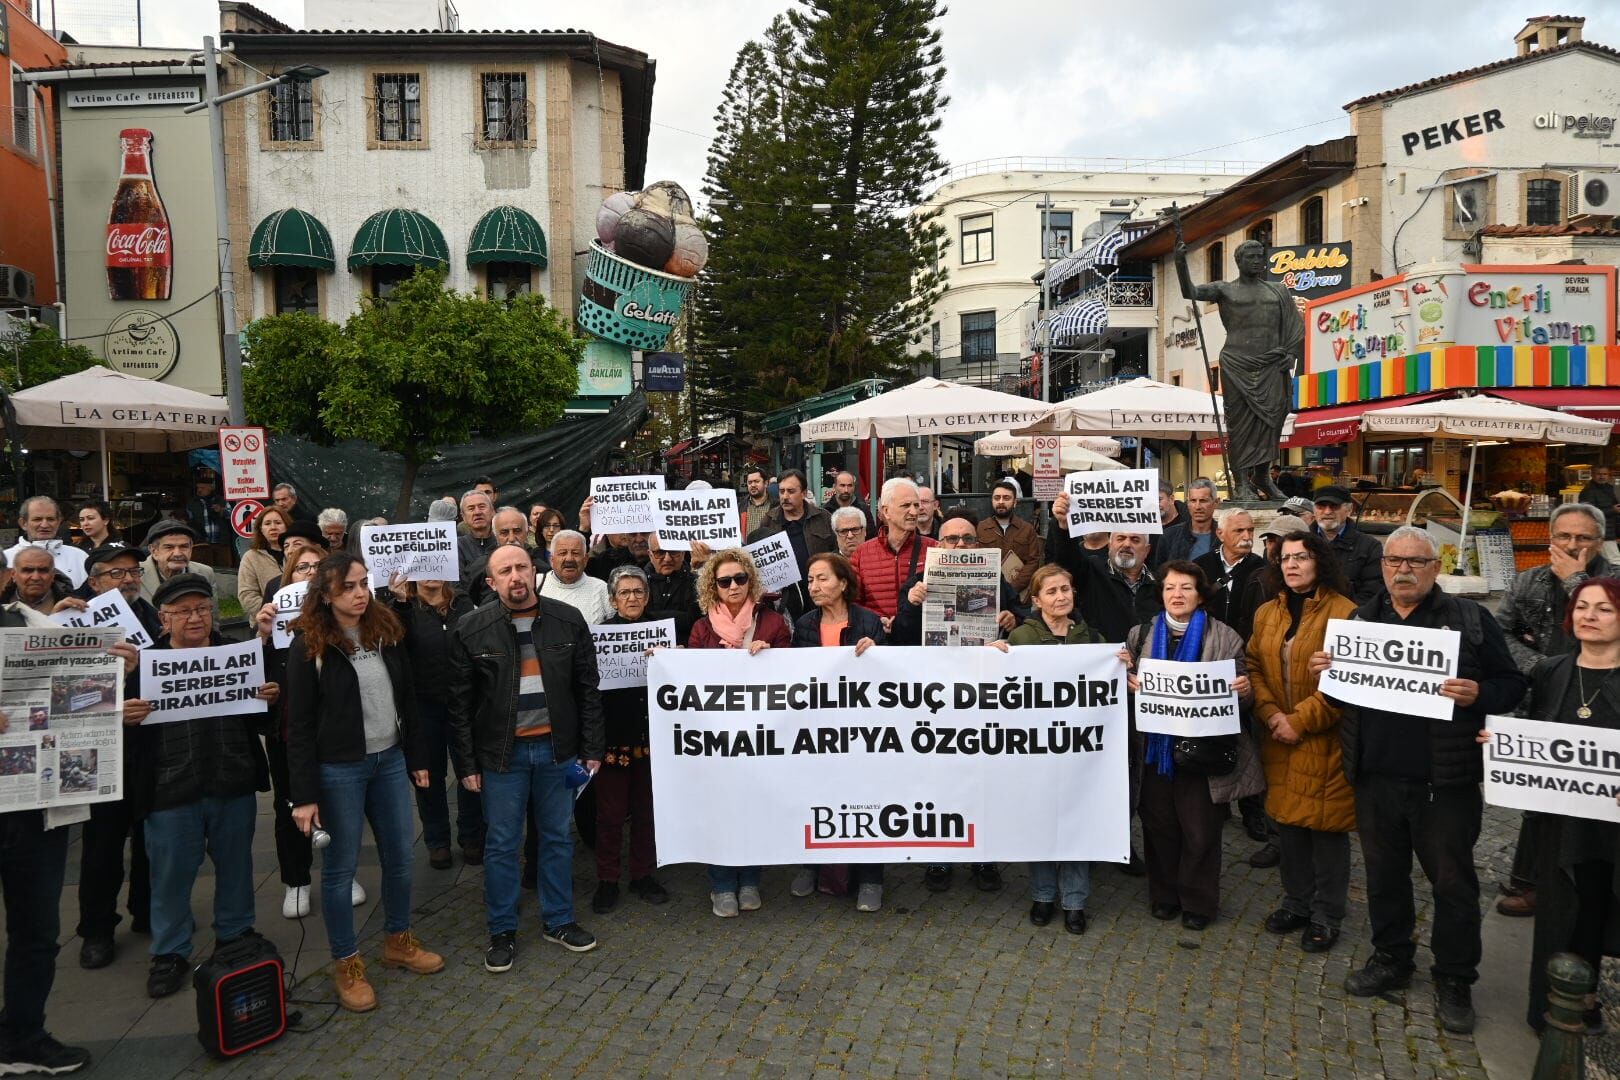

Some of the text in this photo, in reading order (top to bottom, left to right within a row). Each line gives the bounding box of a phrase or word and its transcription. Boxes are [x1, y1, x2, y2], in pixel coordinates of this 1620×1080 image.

[74, 94, 112, 103] Artimo
[115, 93, 141, 102] Cafe
[1535, 111, 1616, 132] ali peker
[1402, 109, 1505, 156] PEKER
[106, 228, 168, 255] Coca-Cola
[1270, 247, 1349, 274] Bubble
[1373, 290, 1391, 300] DEVREN
[1564, 286, 1590, 294] KIRALIK
[590, 368, 623, 378] BAKLAVA
[74, 408, 230, 426] LA GELATERIA
[919, 418, 938, 427] LA
[945, 413, 1041, 425] GELATERIA
[1122, 413, 1142, 423] LA
[1372, 416, 1430, 425] LA GELATERIA
[1470, 420, 1534, 431] GELATERIA
[1567, 427, 1603, 438] GELATERIA
[596, 480, 657, 493] GAZETECİLİK
[1071, 479, 1119, 494] İSMAİL
[1123, 479, 1149, 492] ARI
[594, 494, 610, 504] SUÇ
[658, 497, 730, 511] İSMAİL ARI
[1077, 497, 1143, 509] SERBEST
[665, 513, 725, 526] SERBEST
[1070, 511, 1158, 526] BIRAKILSIN!
[371, 528, 447, 543] GAZETECİLİK
[658, 527, 738, 541] BIRAKILSIN!
[368, 541, 452, 556] SUÇ DEĞİLDİR!
[749, 540, 783, 558] ECİLİK
[754, 550, 789, 569] ĞİLDİR!
[93, 603, 121, 626] ARI
[591, 627, 667, 642] GAZETECİLİK
[595, 645, 611, 655] UÇ
[5, 655, 117, 668] İnatla, ısrarla yazacağız
[152, 652, 256, 676] İSMAİL ARI
[161, 672, 249, 694] SERBEST
[656, 674, 1119, 714] GAZETECİLİK SUÇ DEĞİLDİR!
[1140, 702, 1234, 718] SUSMAYACAK!
[673, 721, 1104, 757] İSMAİL ARI'YA ÖZGÜRLÜK!
